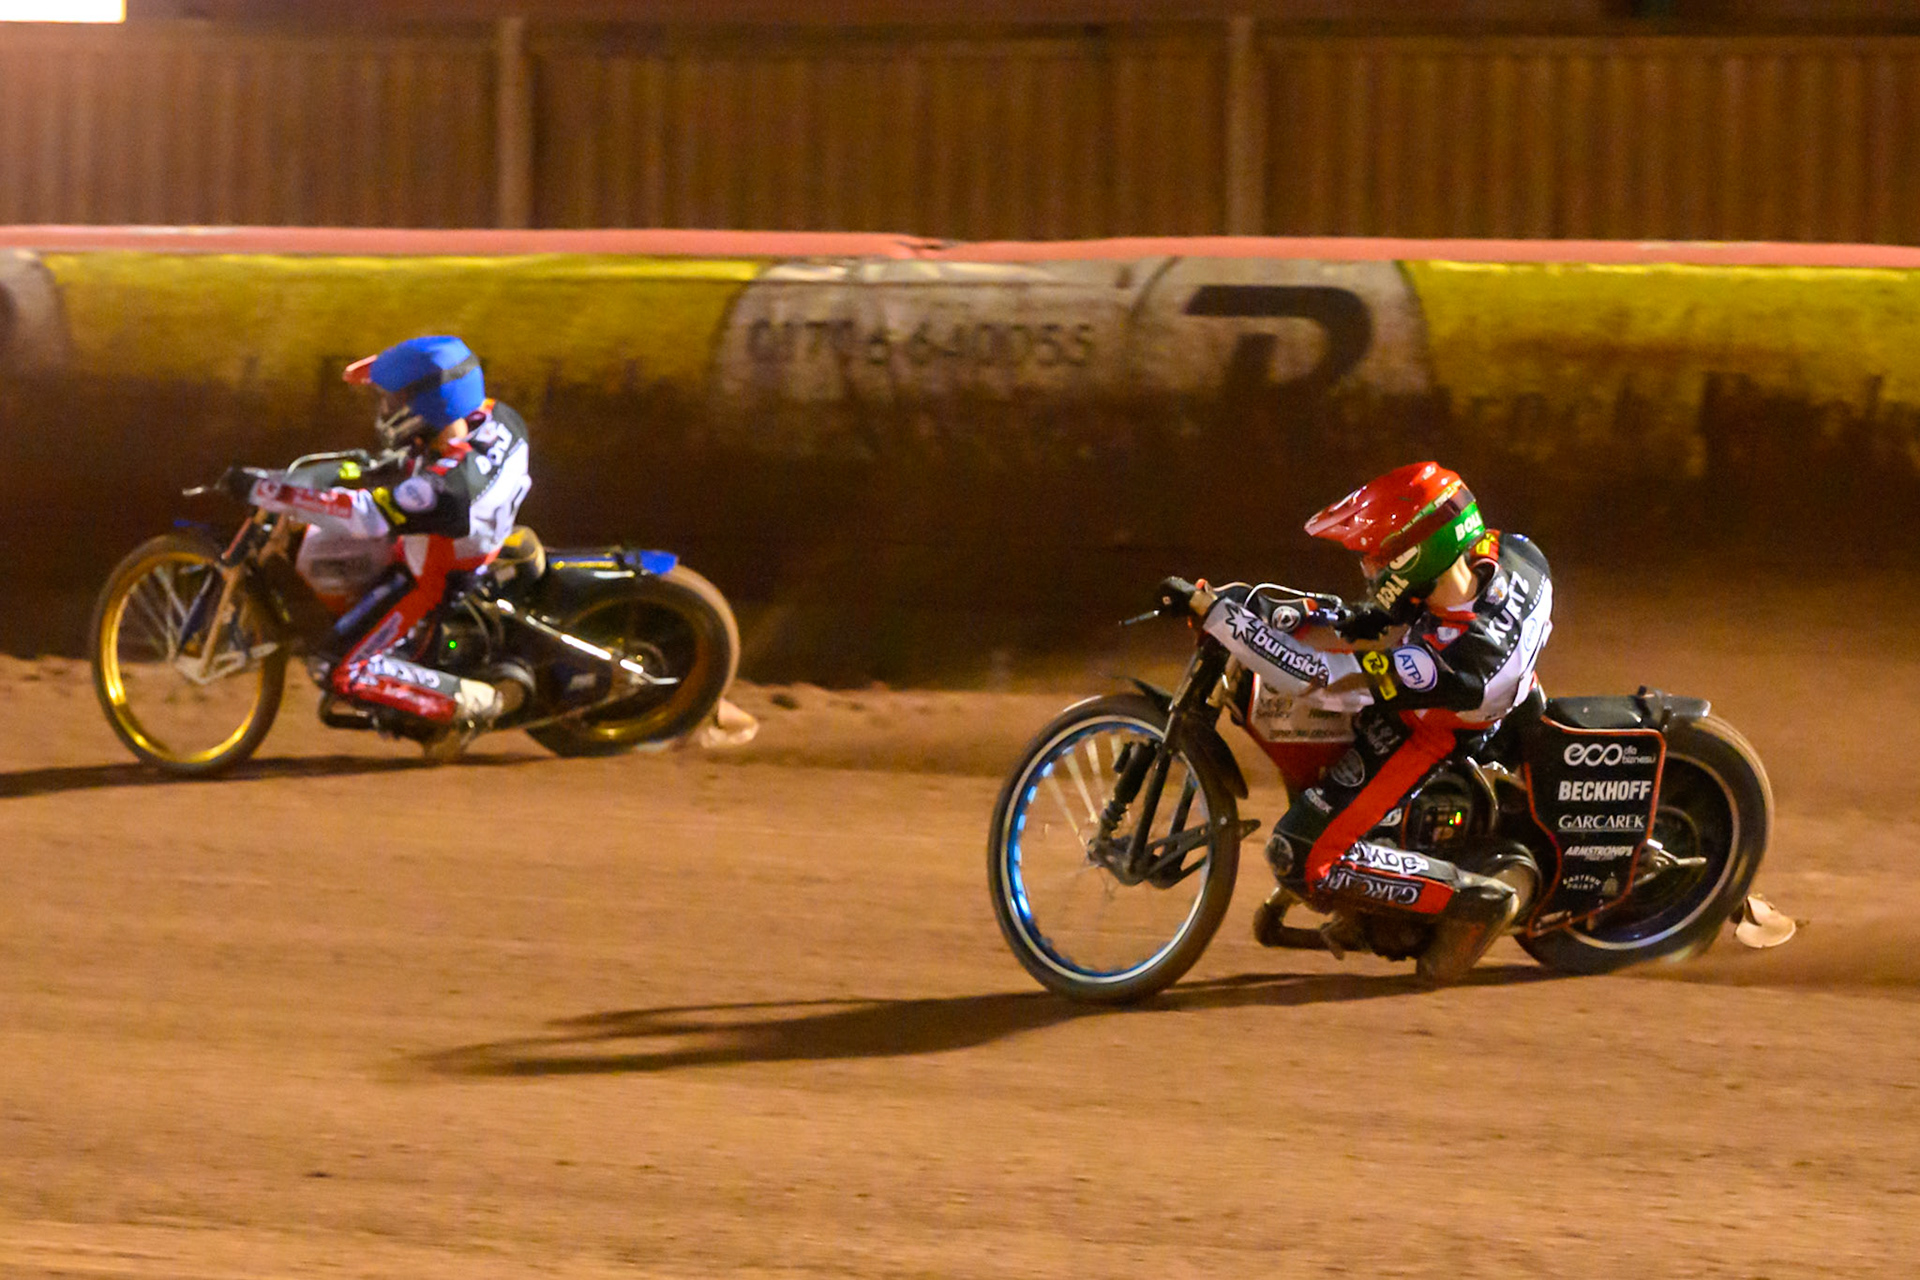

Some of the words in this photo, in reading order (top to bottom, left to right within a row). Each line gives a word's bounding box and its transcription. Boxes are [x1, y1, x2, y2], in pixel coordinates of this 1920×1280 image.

[1485, 571, 1529, 645] KURTZ
[1397, 654, 1425, 685] ATPI
[1558, 781, 1652, 801] BECKHOFF
[1558, 814, 1645, 829] GARCAREK
